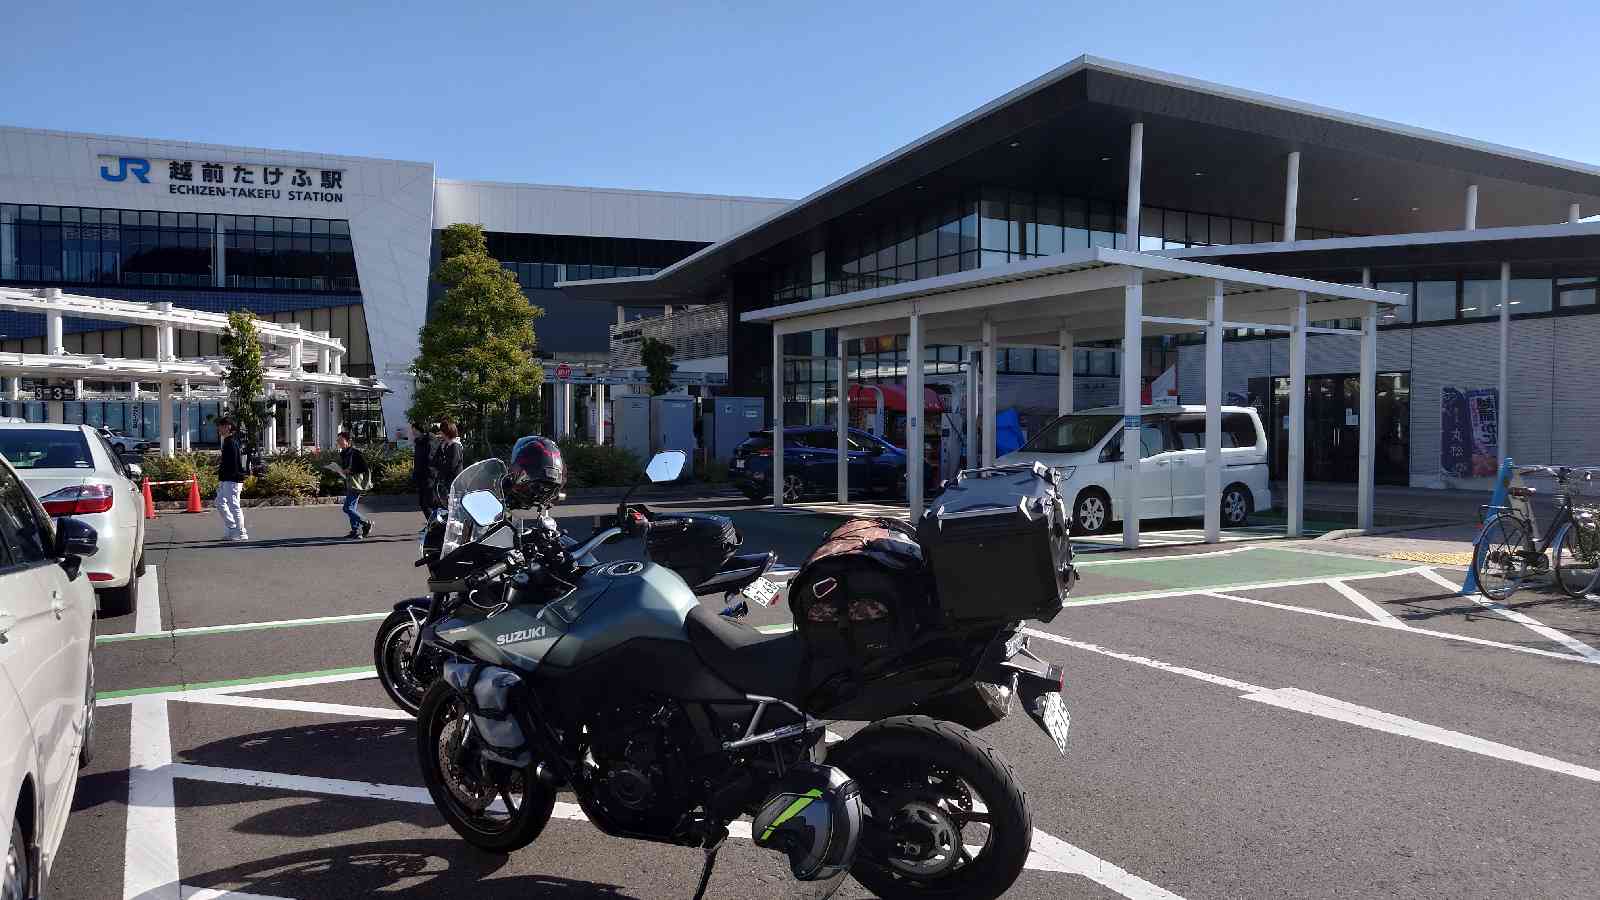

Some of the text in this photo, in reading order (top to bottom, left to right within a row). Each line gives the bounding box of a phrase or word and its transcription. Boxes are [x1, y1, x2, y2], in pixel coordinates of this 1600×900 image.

[101, 157, 151, 183] JR
[169, 160, 343, 189] 越前たけふ駅
[169, 184, 343, 203] ECHIZEN-TAKEFU STATION
[496, 625, 546, 645] SUZUKI
